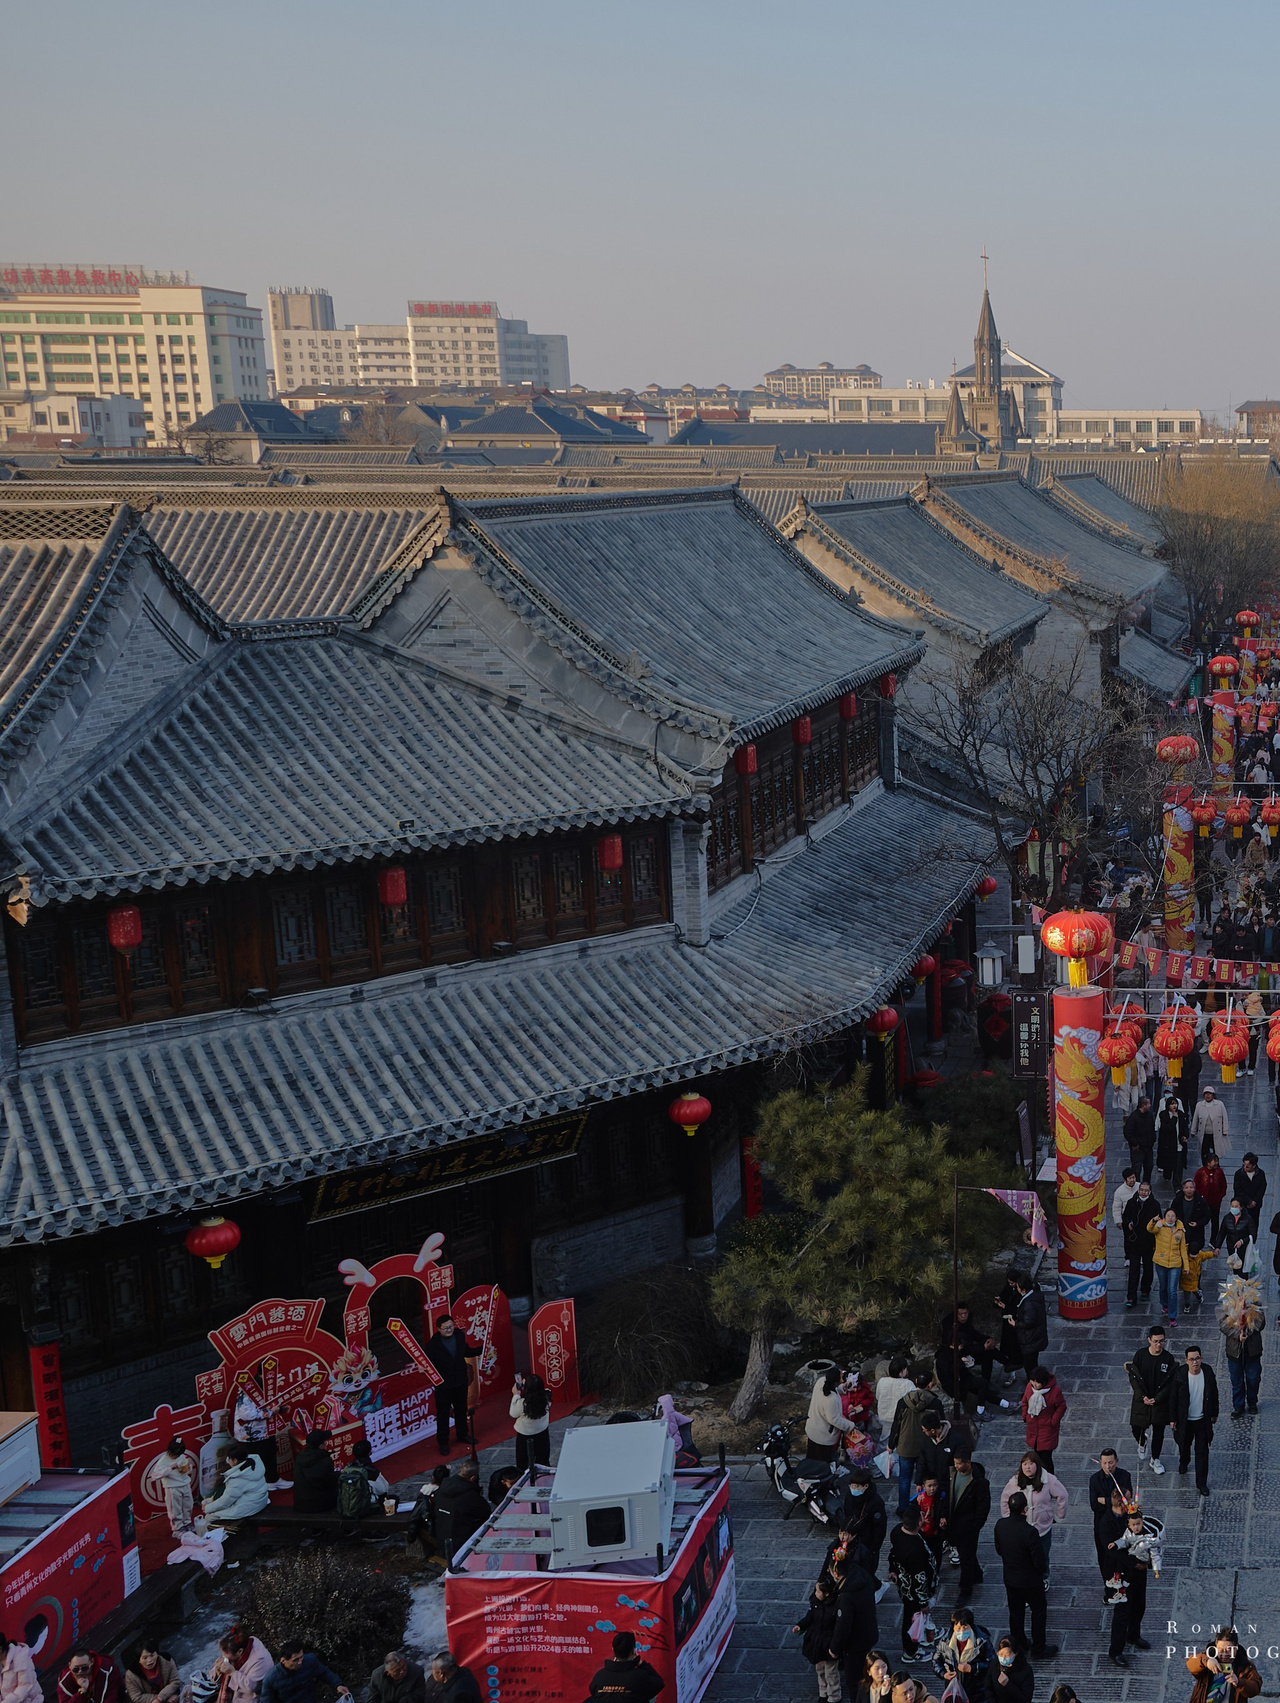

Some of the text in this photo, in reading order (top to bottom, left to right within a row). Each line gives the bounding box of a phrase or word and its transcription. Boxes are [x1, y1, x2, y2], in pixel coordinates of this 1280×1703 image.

[364, 1403, 400, 1434] 新年
[402, 1403, 429, 1424] NEW
[401, 1415, 436, 1437] YEAR
